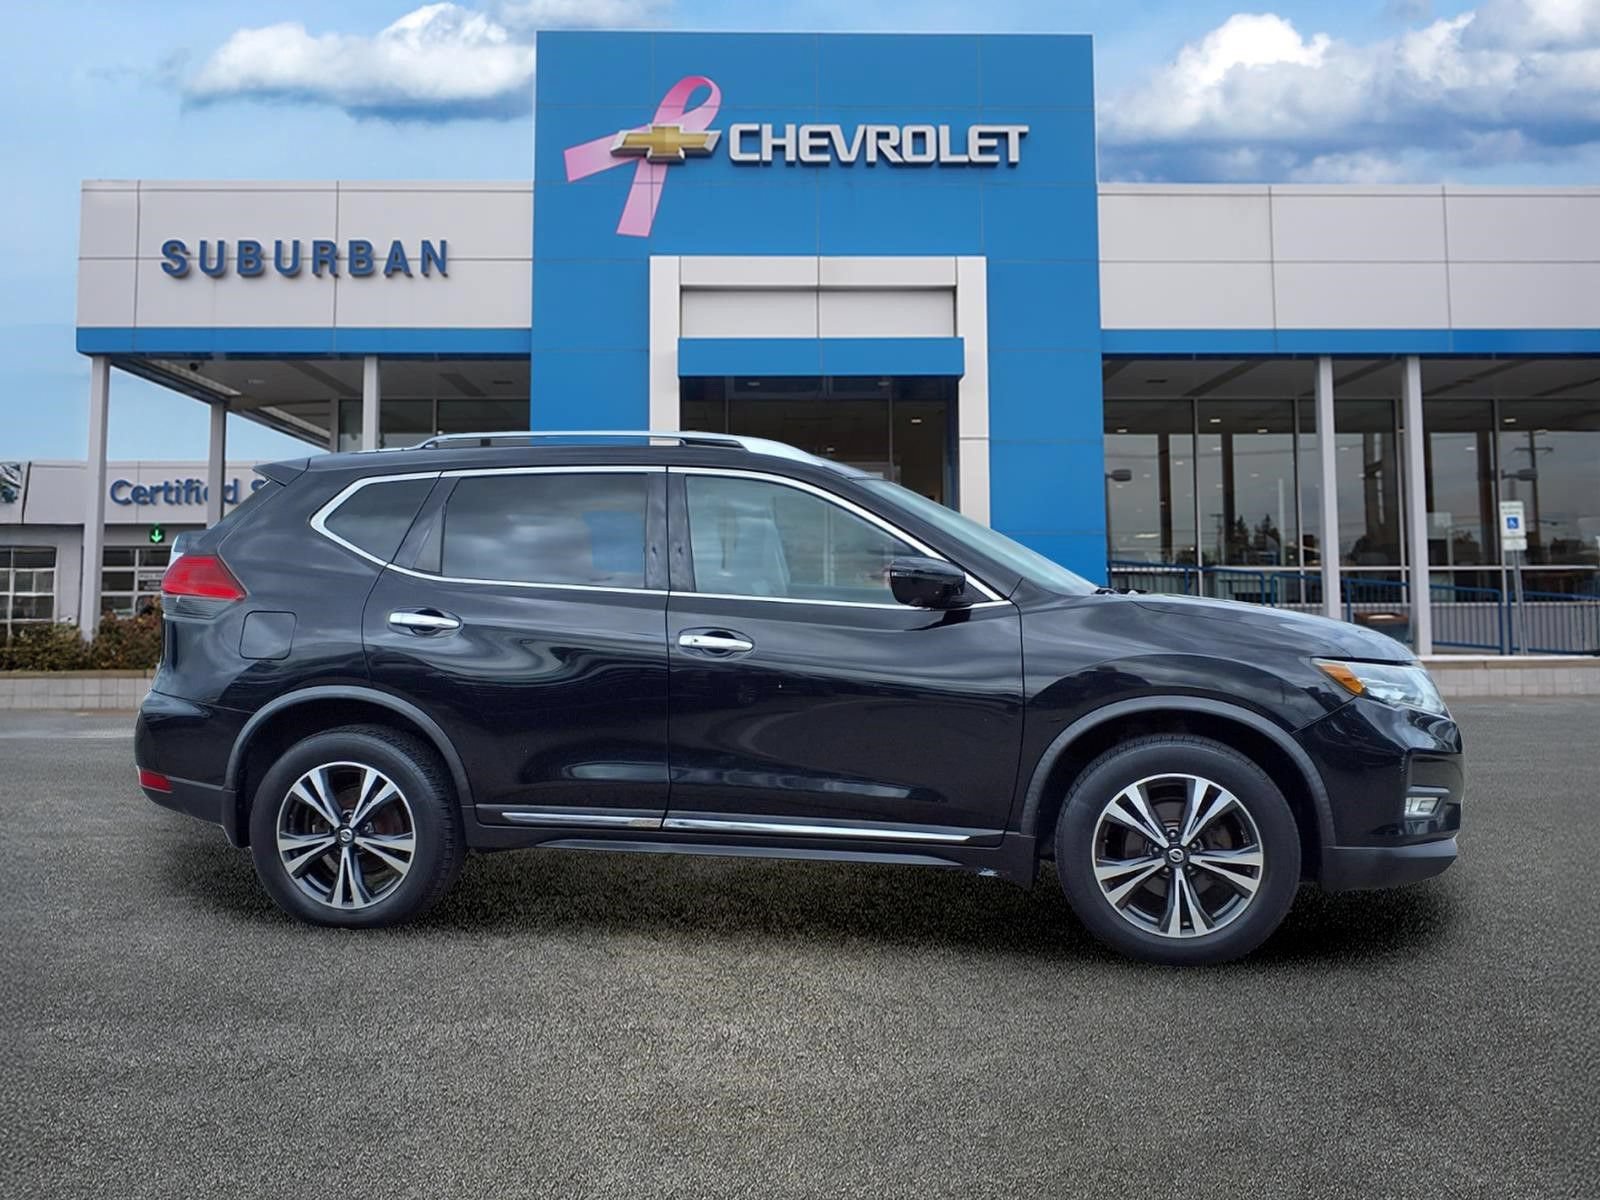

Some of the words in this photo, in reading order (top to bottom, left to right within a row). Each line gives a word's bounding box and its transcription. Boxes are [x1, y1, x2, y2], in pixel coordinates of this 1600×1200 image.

[729, 123, 1029, 166] CHEVROLET
[161, 239, 448, 278] SUBURBAN
[110, 478, 239, 506] Certifid
